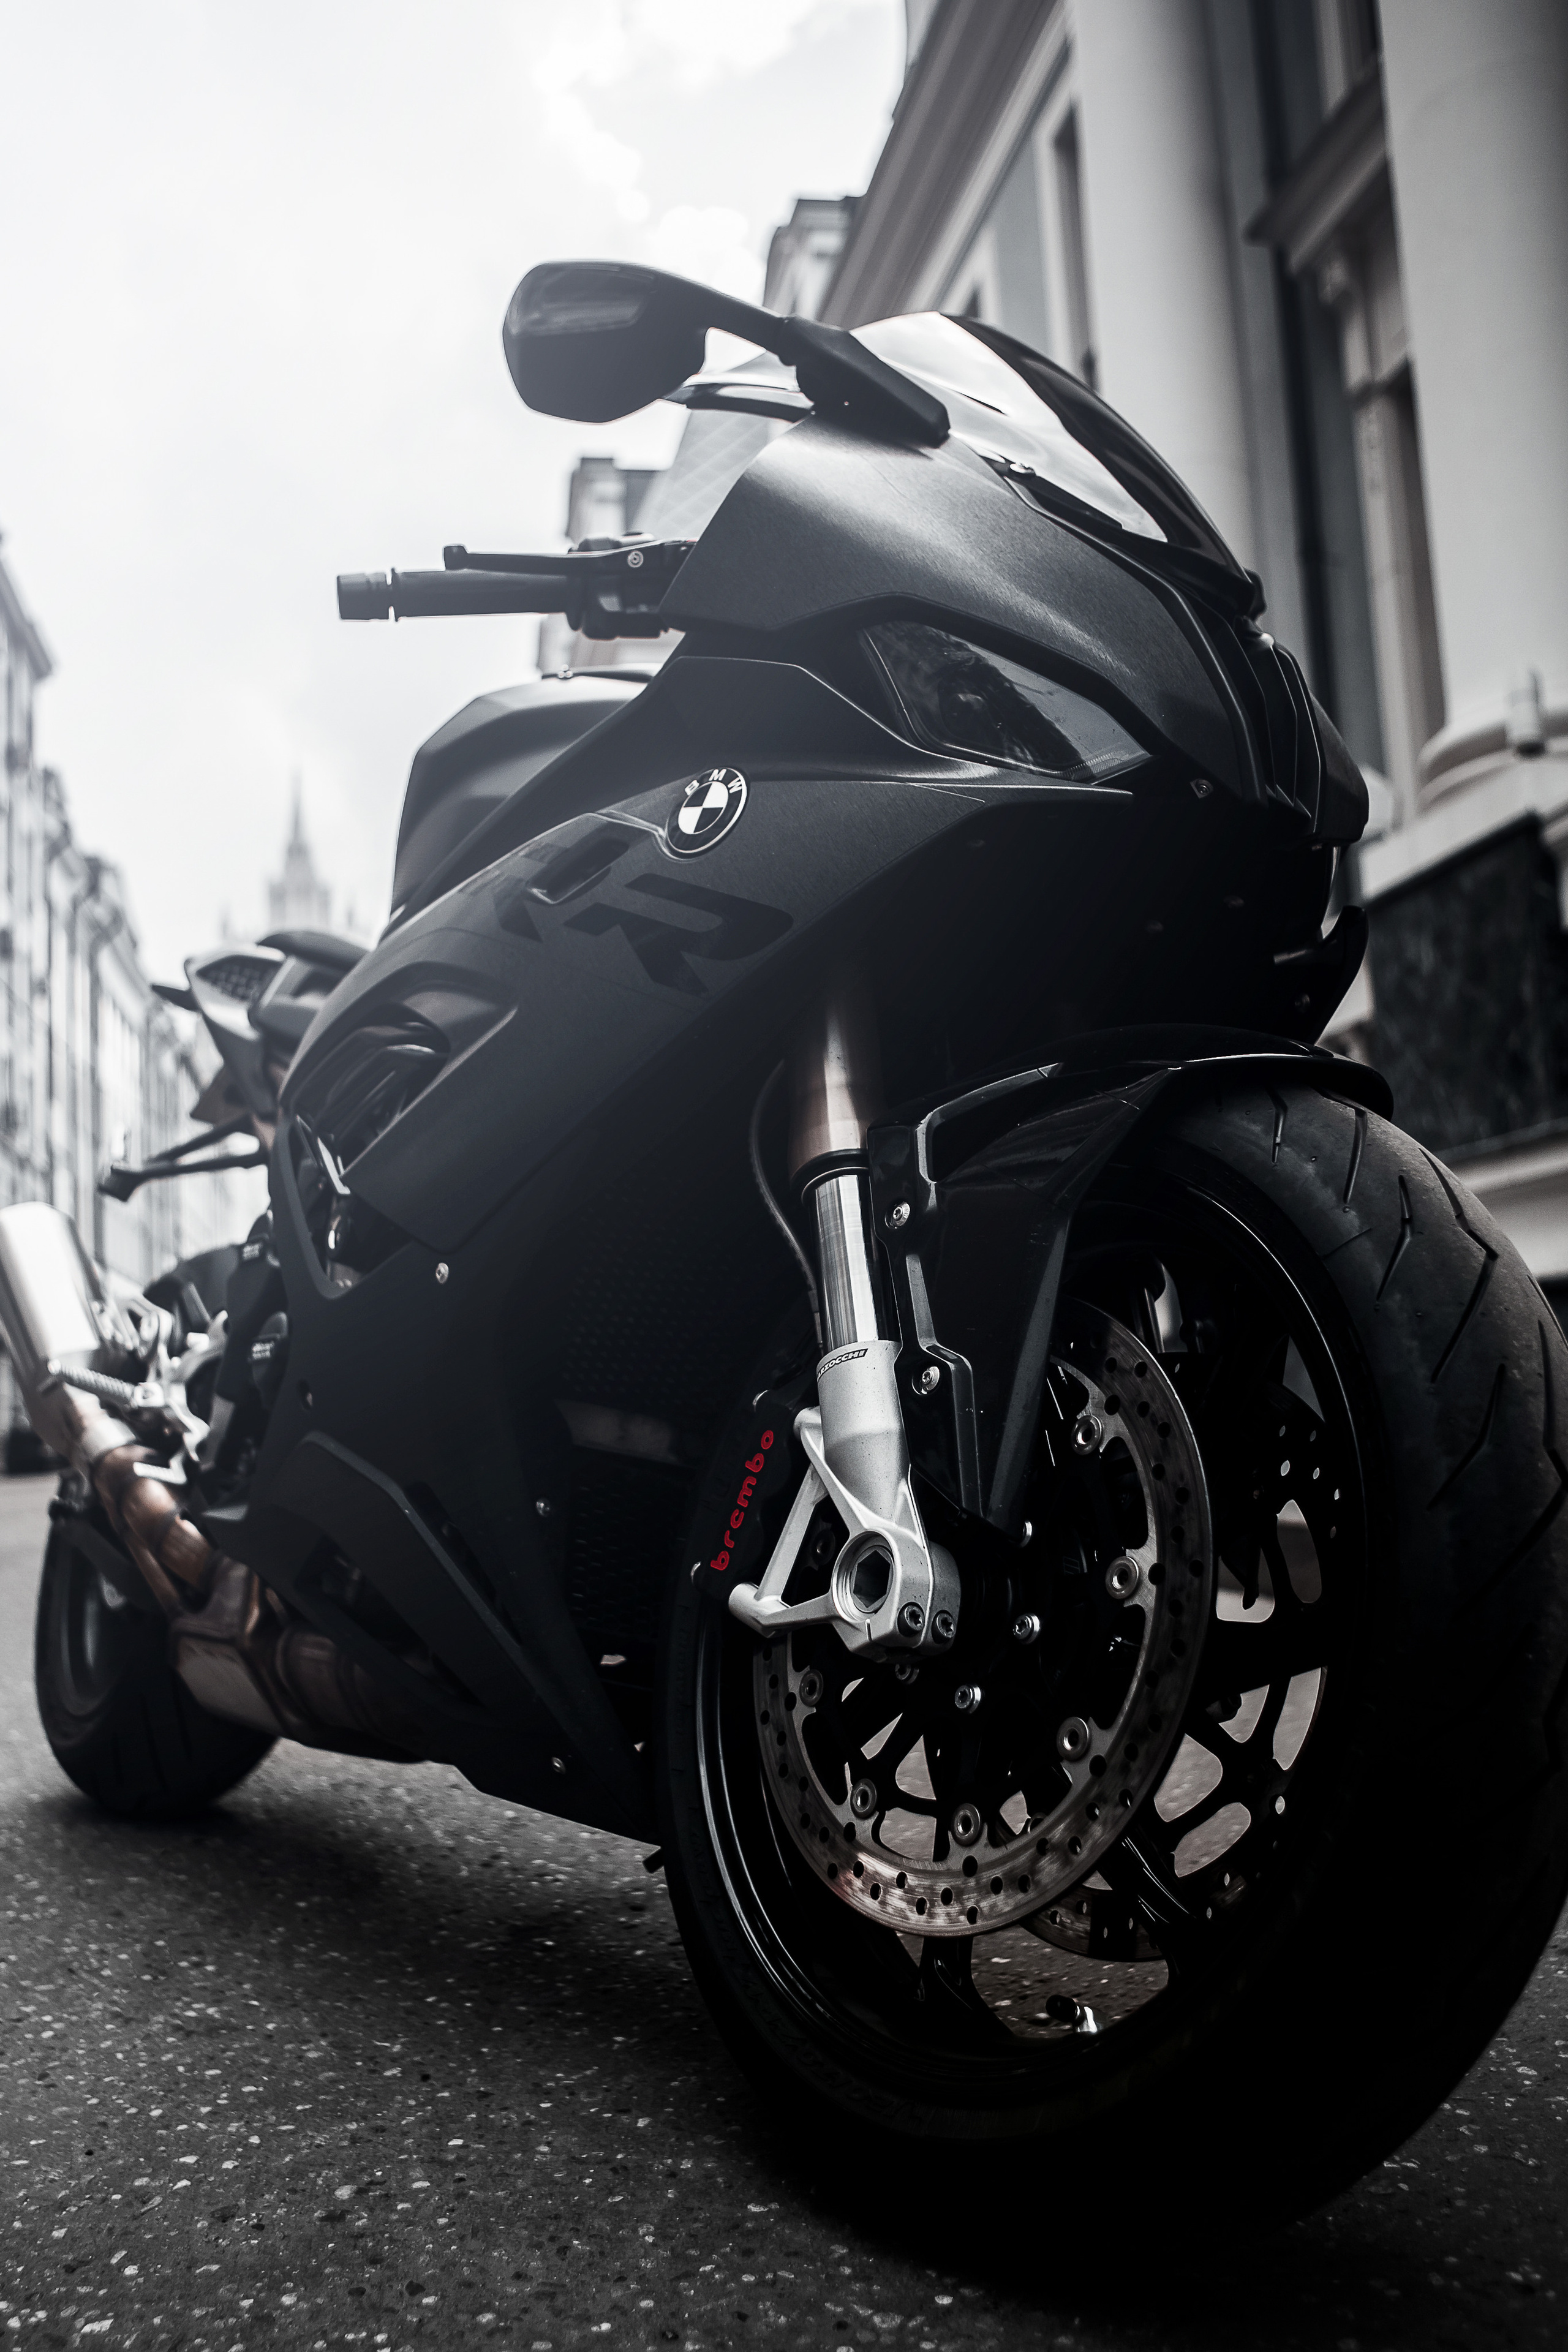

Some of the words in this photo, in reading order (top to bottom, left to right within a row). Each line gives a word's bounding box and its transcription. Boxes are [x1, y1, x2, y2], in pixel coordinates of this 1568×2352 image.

[684, 768, 742, 796] BMW
[817, 1349, 866, 1382] ARZOCCHI
[710, 1430, 774, 1571] brembo
